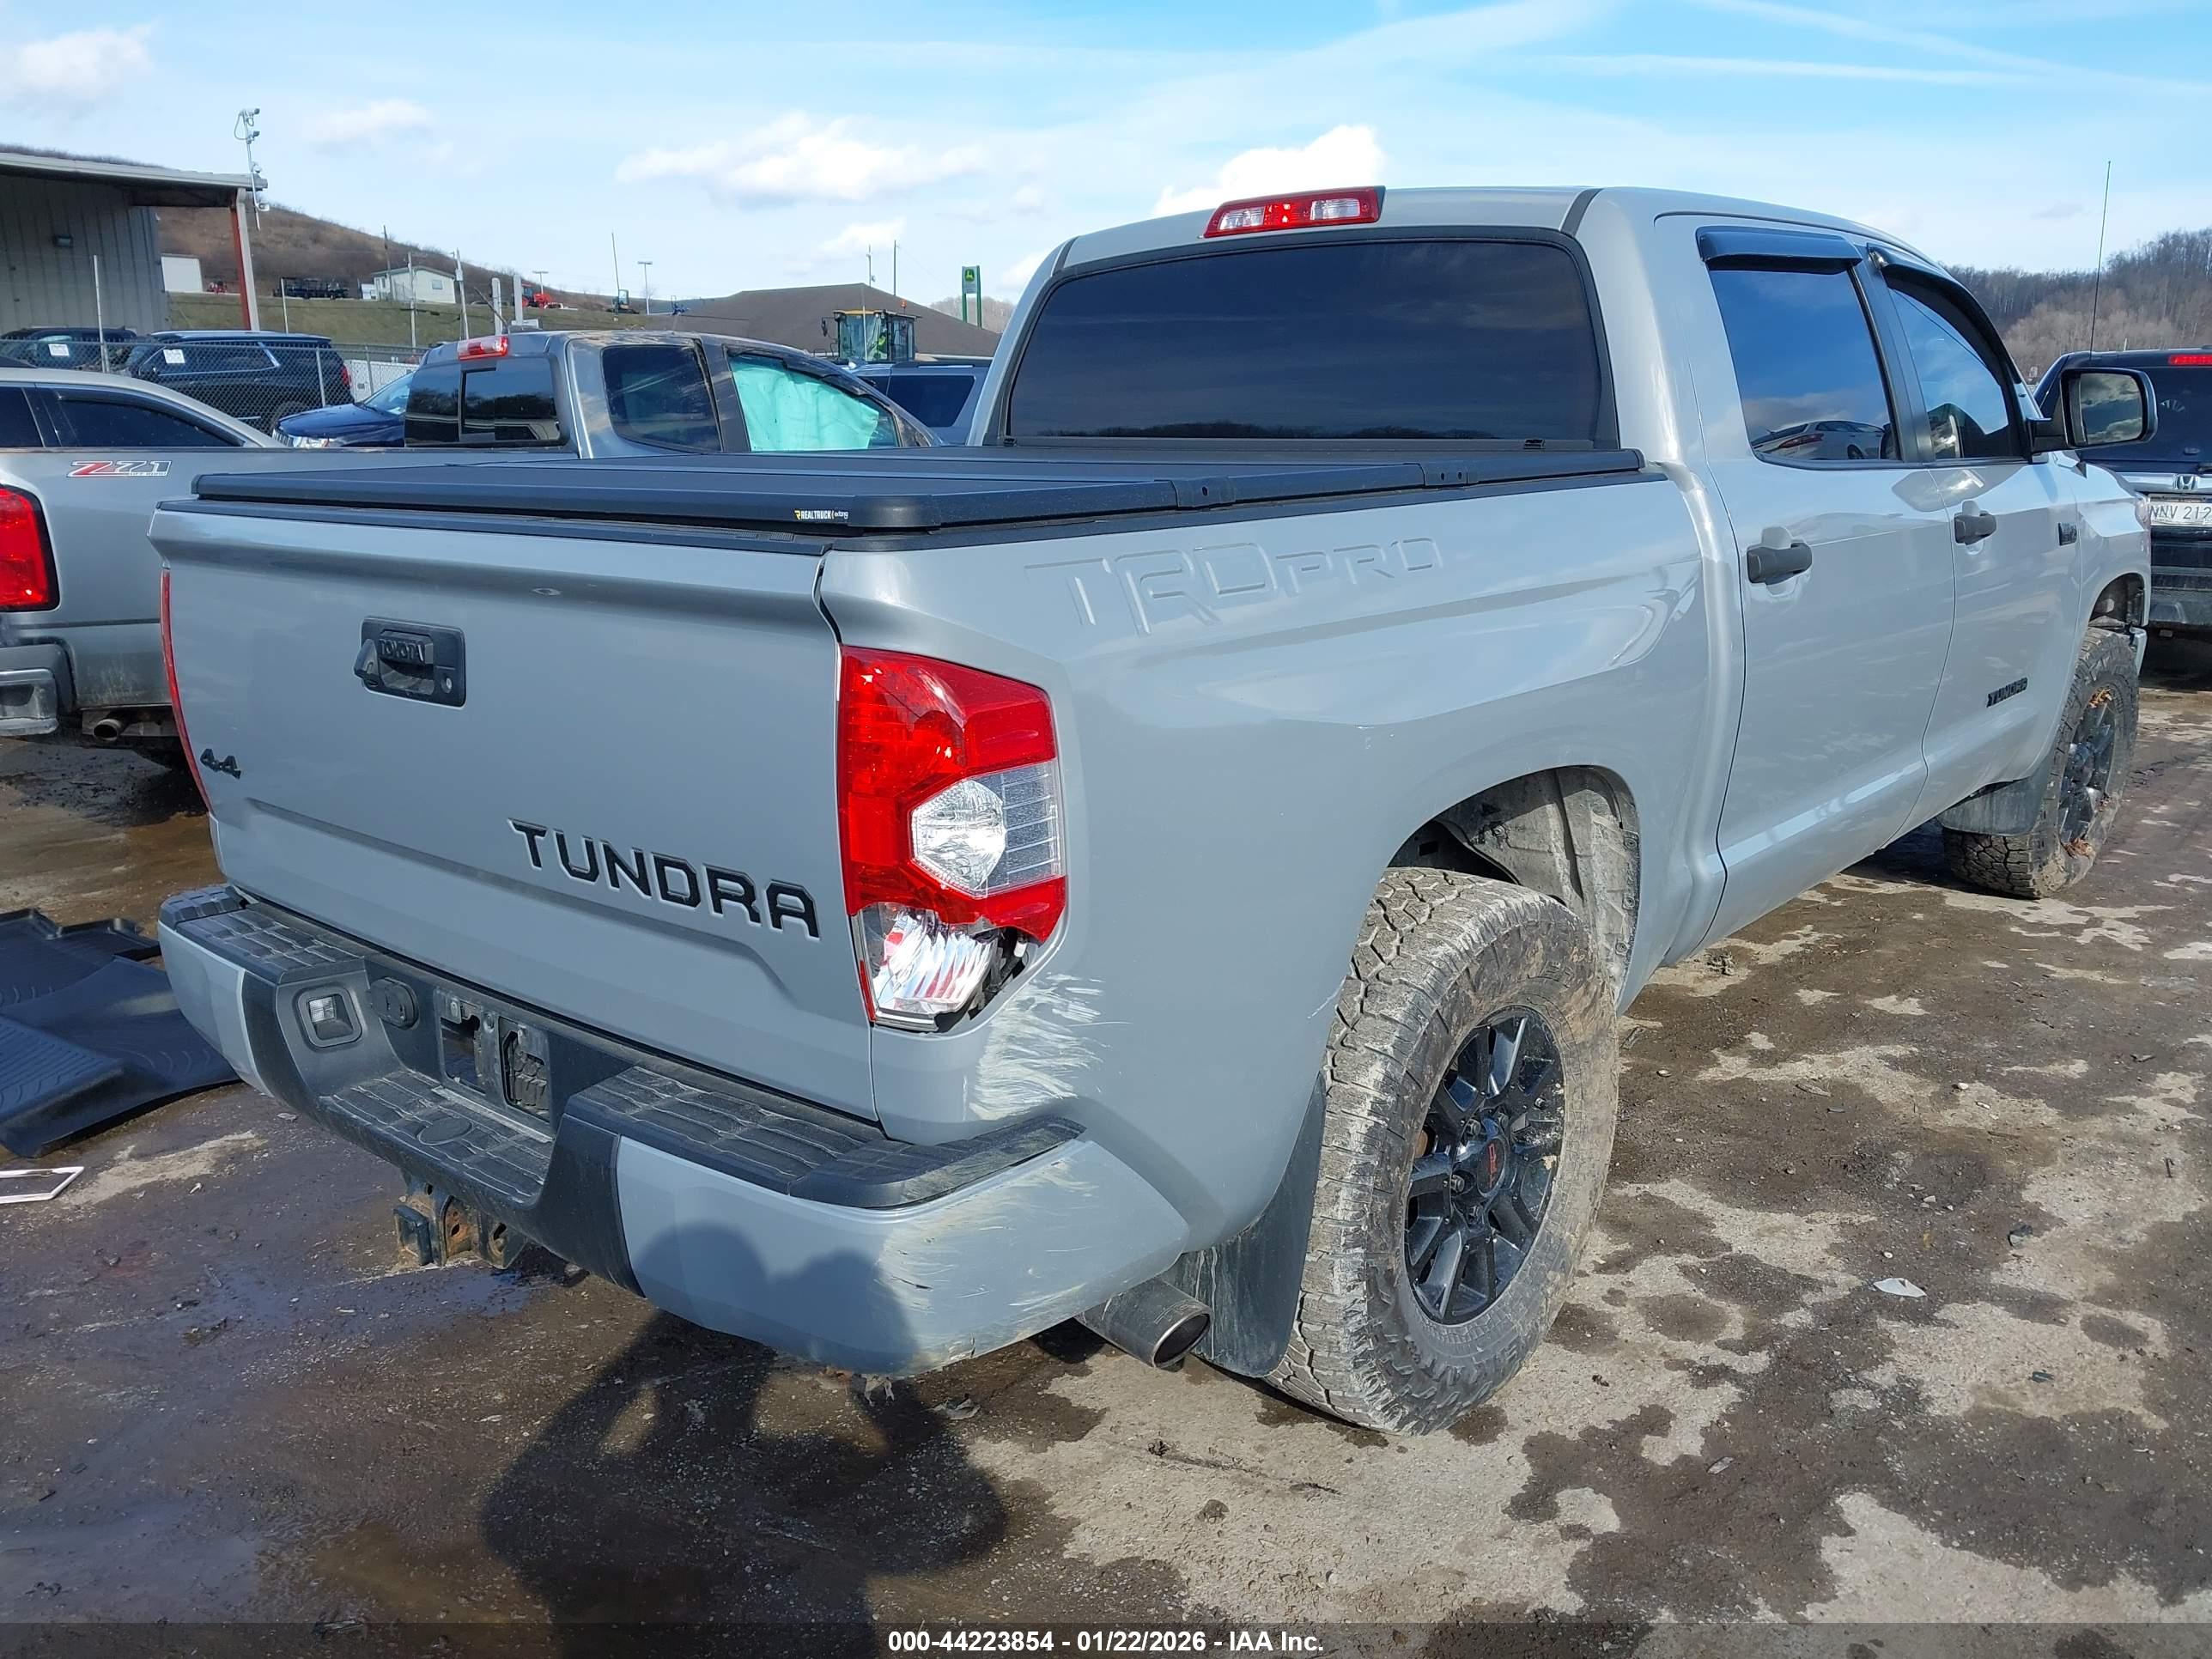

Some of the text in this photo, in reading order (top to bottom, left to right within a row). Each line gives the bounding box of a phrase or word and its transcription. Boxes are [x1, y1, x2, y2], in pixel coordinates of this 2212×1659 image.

[67, 460, 172, 477] Z71
[800, 509, 832, 520] REALTRUCK
[1024, 537, 1443, 635] TRD PRO
[1986, 677, 2028, 708] TUNDRA
[507, 817, 821, 942] TUNDRA
